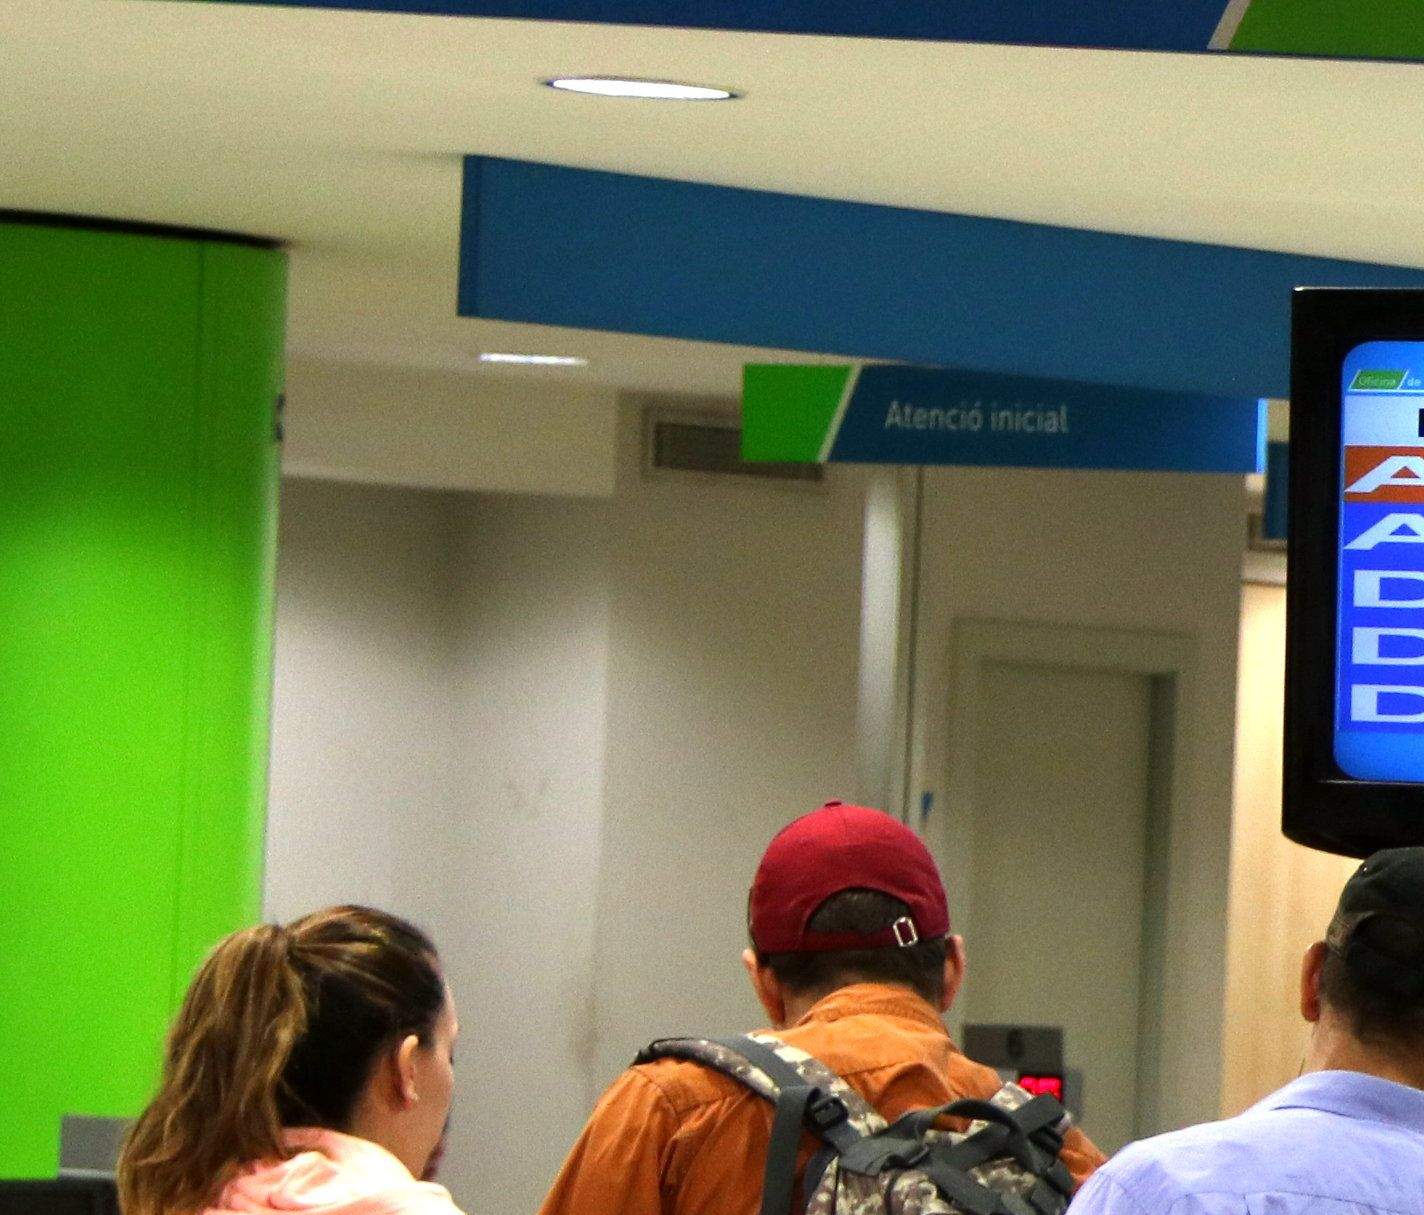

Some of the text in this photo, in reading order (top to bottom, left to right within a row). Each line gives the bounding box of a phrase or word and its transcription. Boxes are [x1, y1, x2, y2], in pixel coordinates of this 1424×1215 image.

[1407, 377, 1421, 387] de
[885, 400, 1070, 434] Atenció inicial
